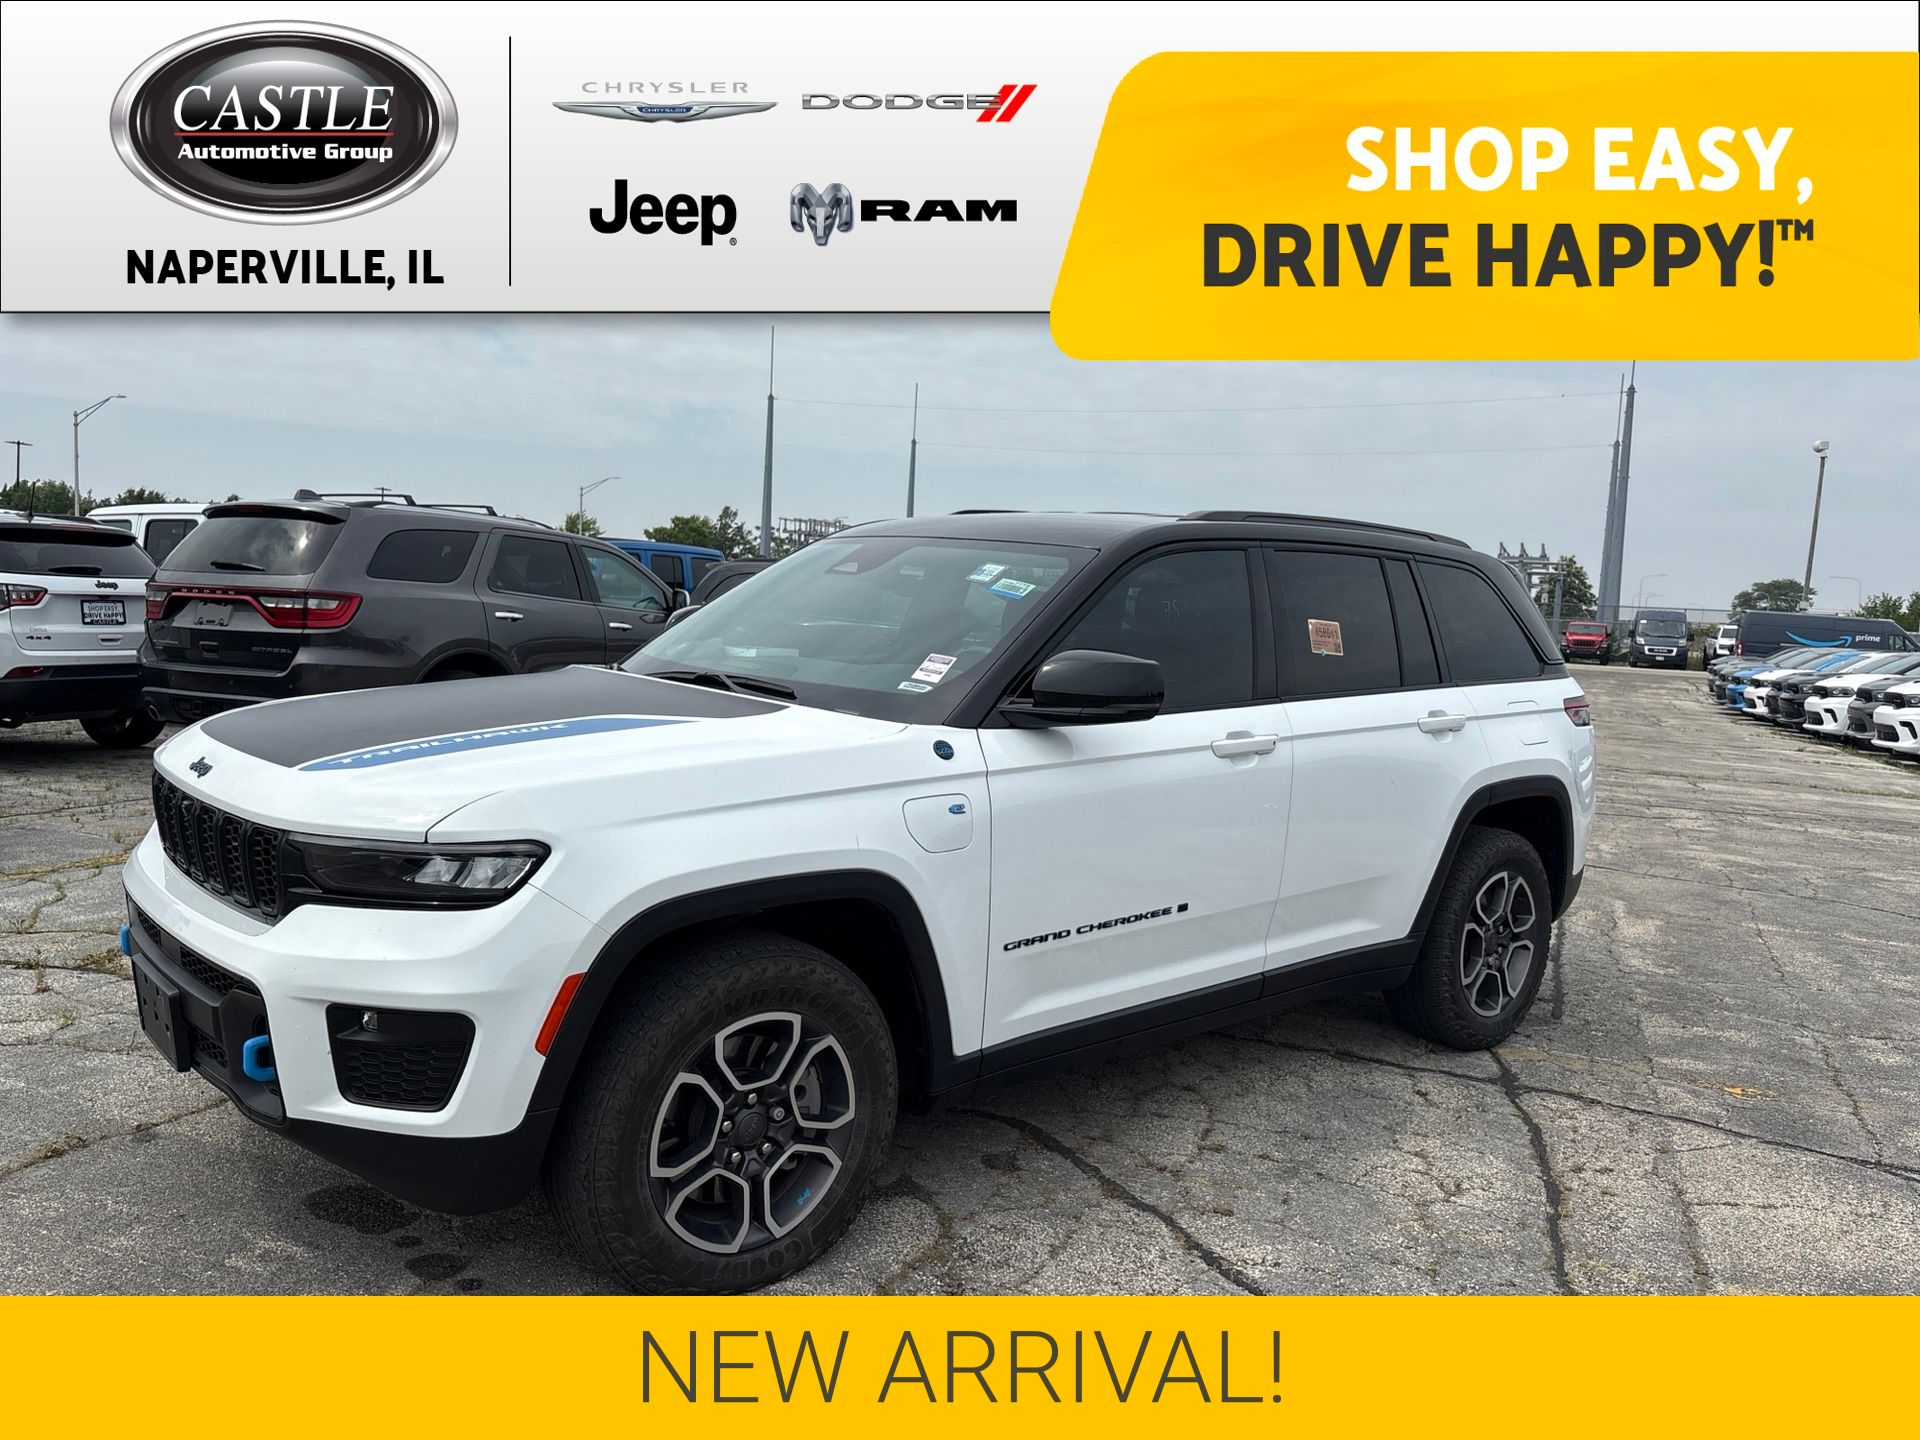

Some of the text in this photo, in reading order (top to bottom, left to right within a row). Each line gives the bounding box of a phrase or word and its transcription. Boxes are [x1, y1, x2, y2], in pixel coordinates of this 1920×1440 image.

[95, 580, 119, 590] Jeep
[1855, 634, 1881, 644] prime
[328, 723, 569, 764] TRAILHAWK
[189, 756, 214, 779] Jeep
[1003, 905, 1173, 952] GRAND CHEROKEE
